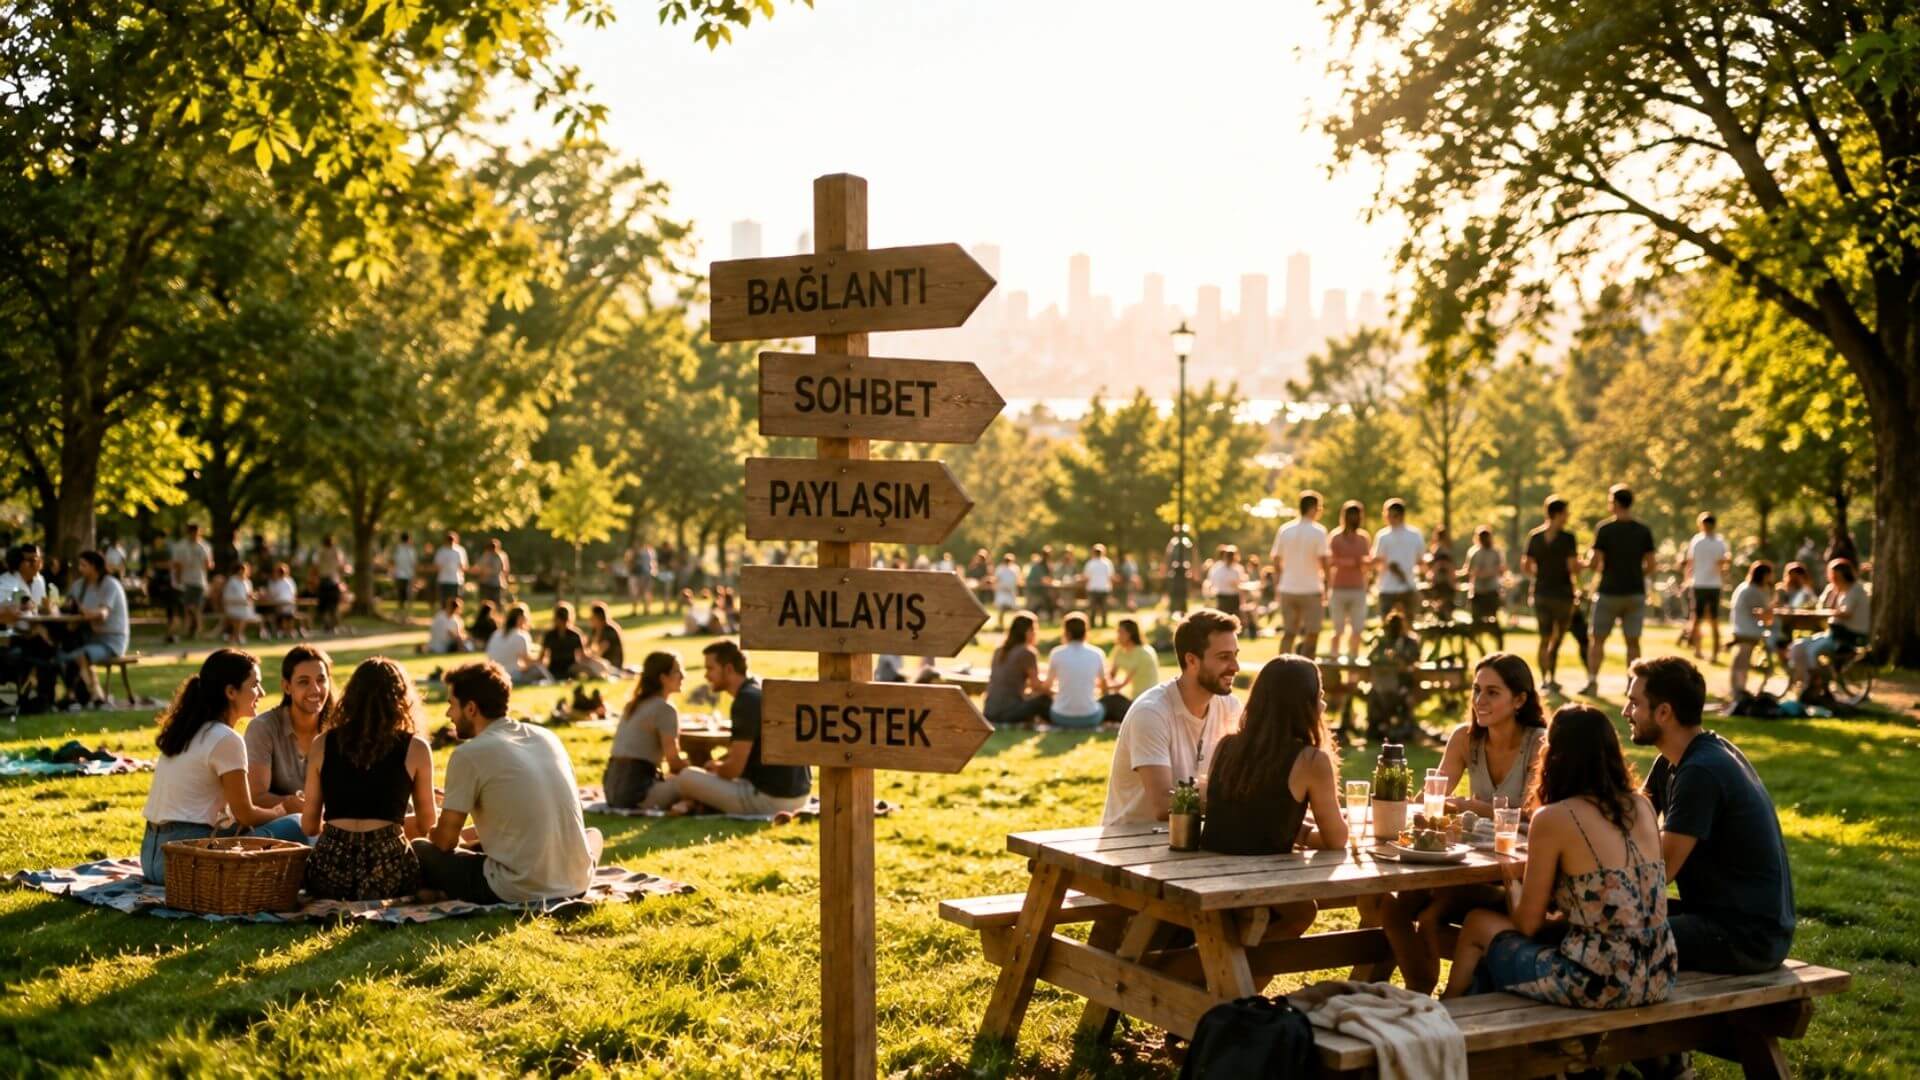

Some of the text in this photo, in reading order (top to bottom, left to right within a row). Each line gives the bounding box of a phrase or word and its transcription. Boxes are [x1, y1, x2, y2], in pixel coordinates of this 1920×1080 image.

[747, 266, 927, 317] BAĞLANTI
[794, 376, 937, 418] SOHBET
[769, 480, 931, 527] PAYLAŞIM
[778, 589, 927, 640] ANLAYIŞ
[795, 704, 931, 748] DESTEK
